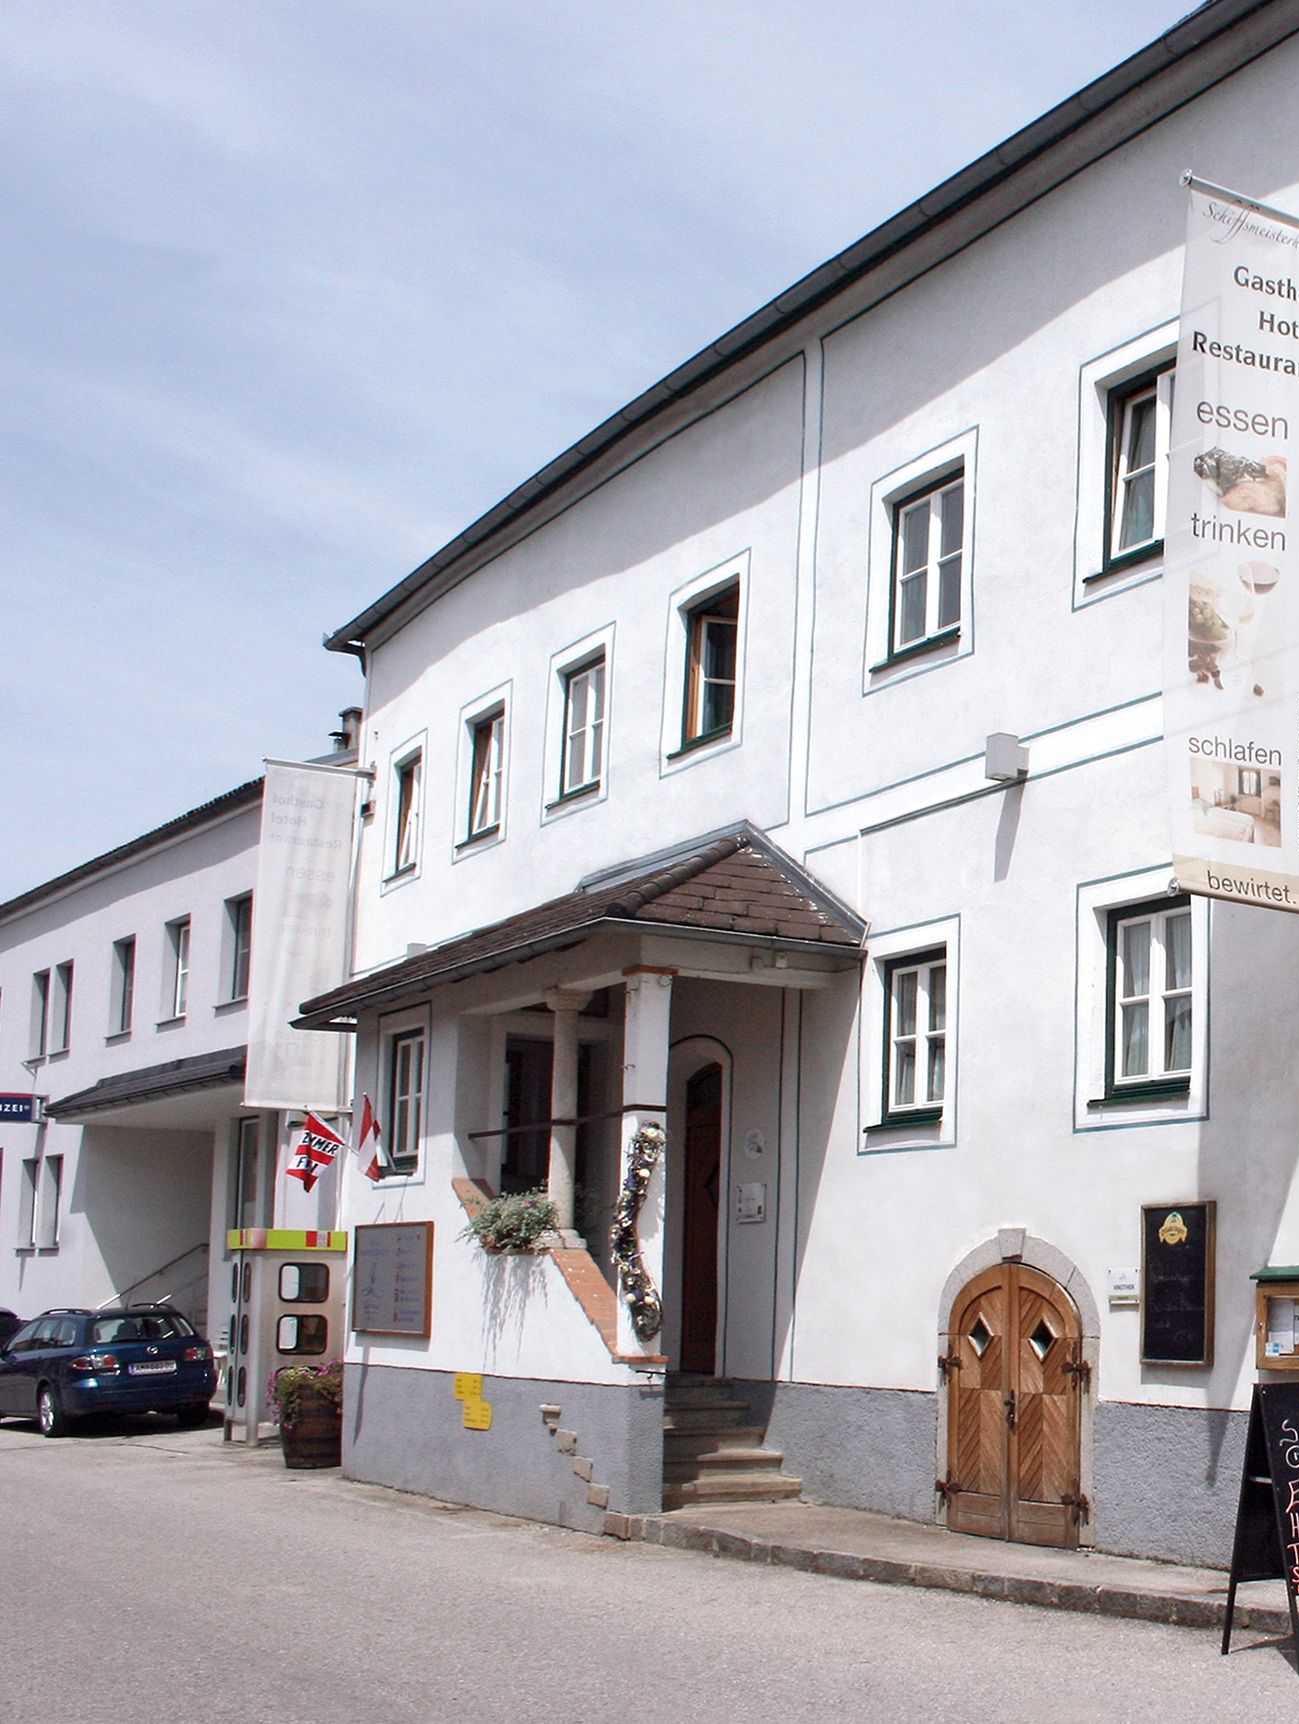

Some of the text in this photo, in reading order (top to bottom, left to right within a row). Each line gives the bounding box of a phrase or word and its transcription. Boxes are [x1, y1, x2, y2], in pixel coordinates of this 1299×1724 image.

[1196, 401, 1289, 439] essen
[1191, 512, 1286, 551] trinken
[1188, 736, 1283, 766] schlafen
[1206, 870, 1297, 905] bewirtet.
